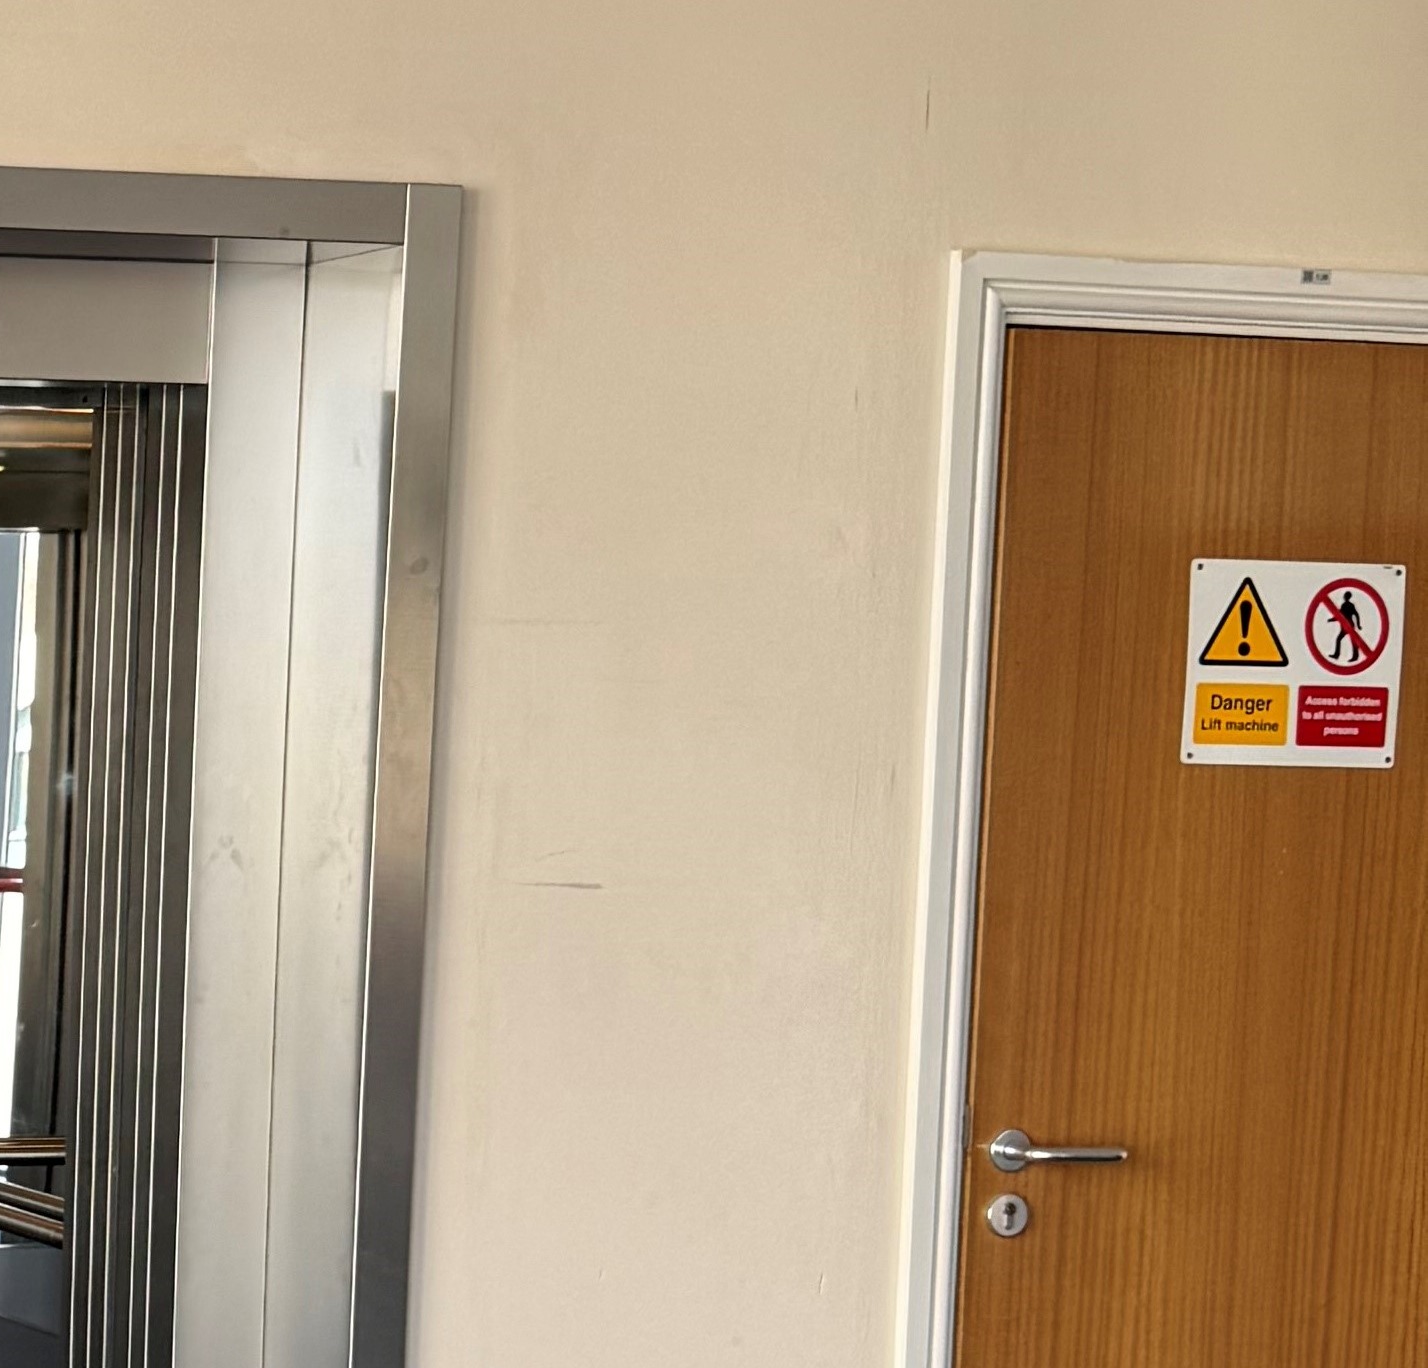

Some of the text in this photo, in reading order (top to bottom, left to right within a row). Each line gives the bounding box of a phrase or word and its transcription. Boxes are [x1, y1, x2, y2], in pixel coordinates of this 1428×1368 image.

[1210, 694, 1273, 715] Danger
[1305, 696, 1381, 707] Access forbidden
[1302, 711, 1312, 720] to
[1313, 710, 1324, 720] all
[1201, 718, 1279, 732] Lift machine
[1323, 727, 1359, 737] persons
